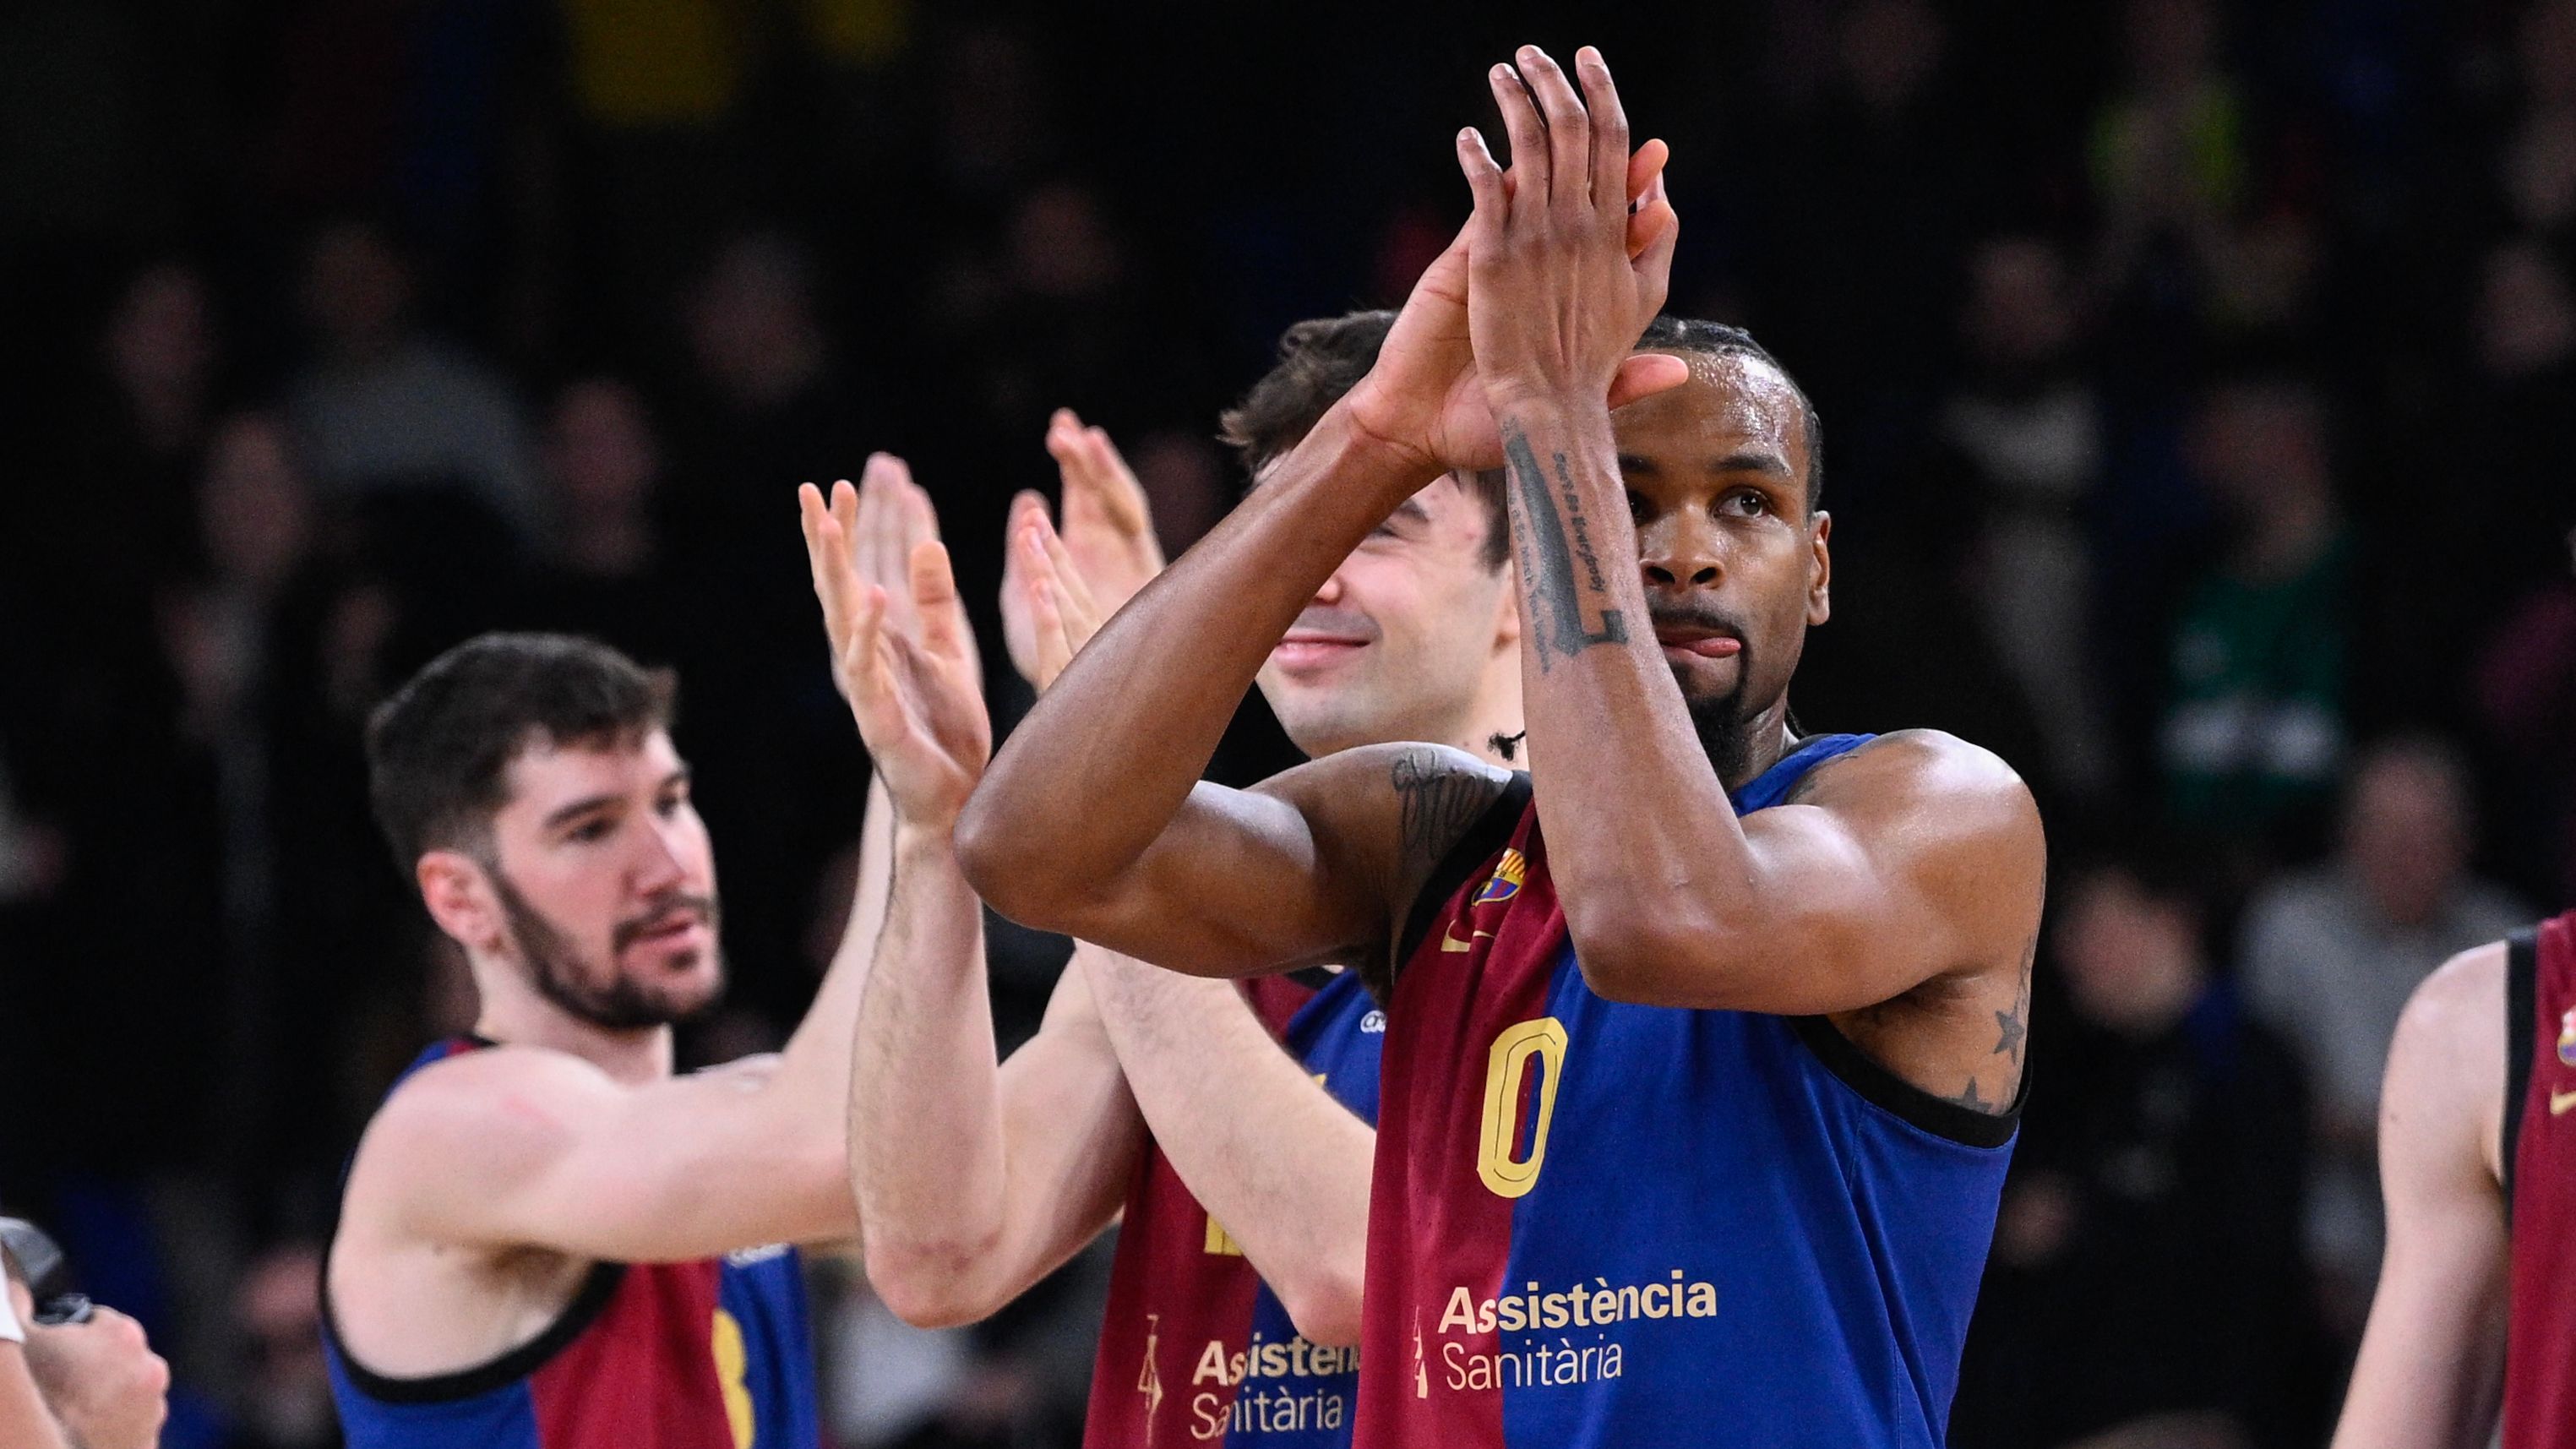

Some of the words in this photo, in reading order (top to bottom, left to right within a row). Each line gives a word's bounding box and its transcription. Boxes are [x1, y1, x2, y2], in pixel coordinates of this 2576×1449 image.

[1477, 1016, 1568, 1198] 0
[1438, 1269, 1717, 1334] Assistència
[1442, 1333, 1622, 1390] Sanitària
